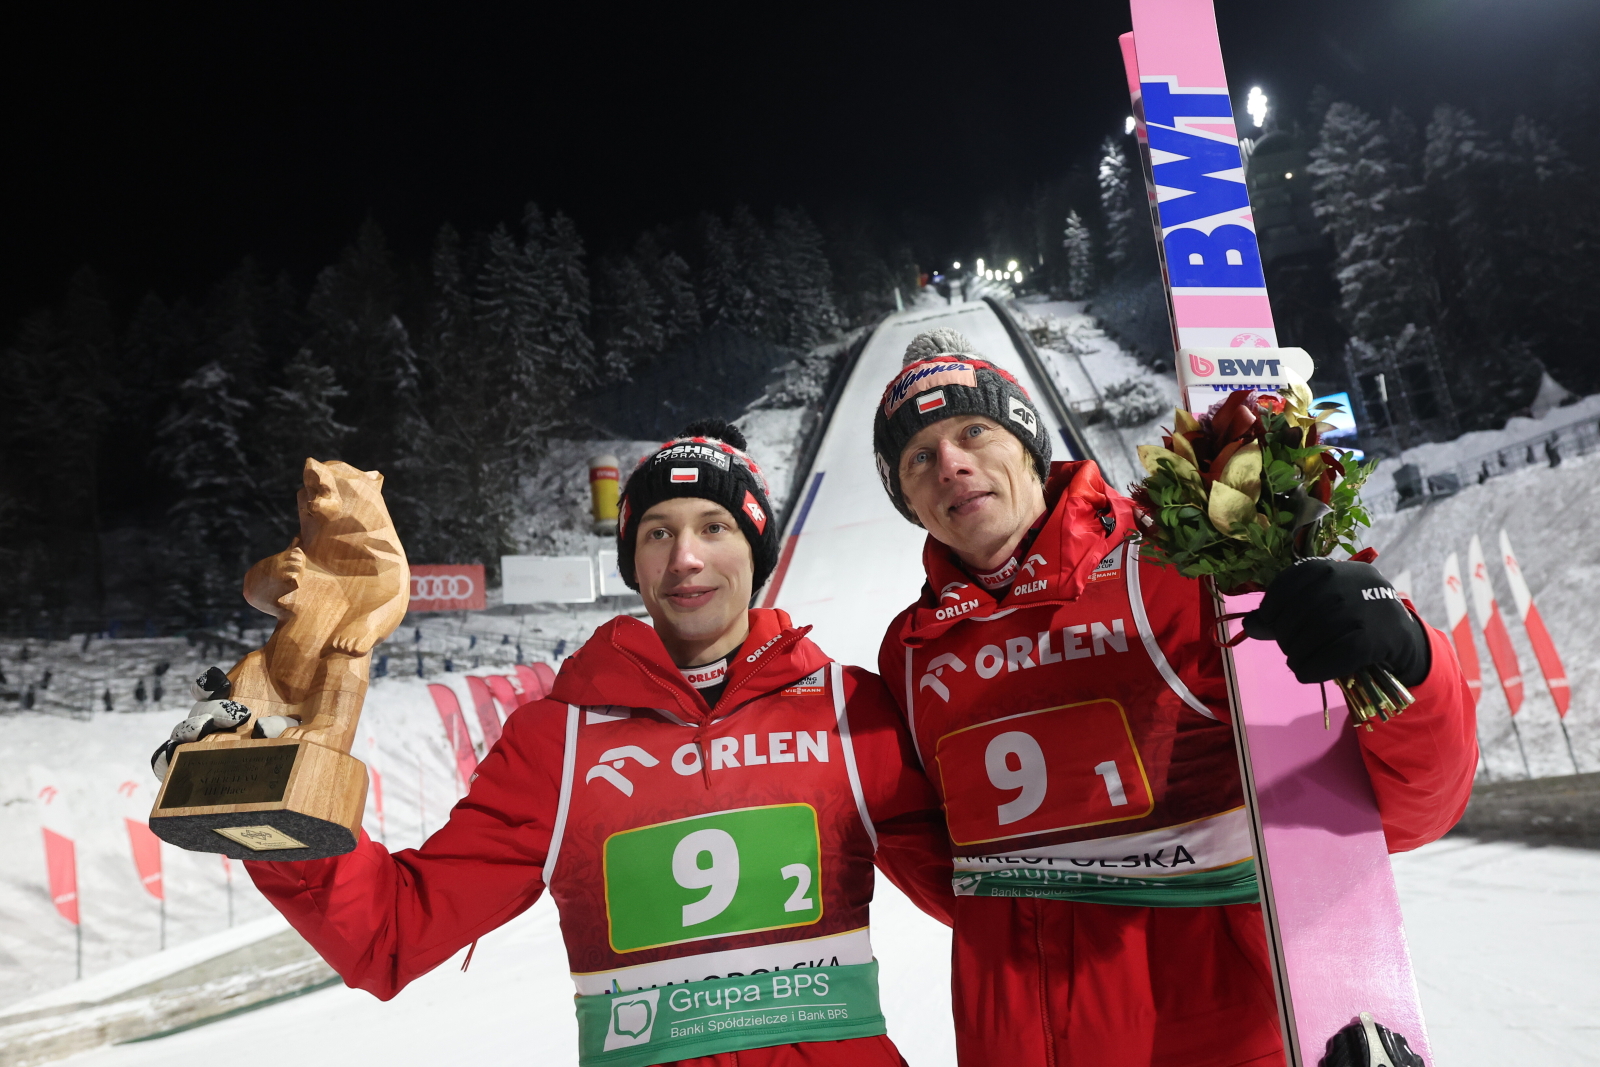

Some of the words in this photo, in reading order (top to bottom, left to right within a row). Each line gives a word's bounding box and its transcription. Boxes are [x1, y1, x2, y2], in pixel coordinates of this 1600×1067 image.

[1140, 81, 1266, 288] BWT
[1218, 359, 1280, 376] BWT
[887, 362, 972, 410] Manner
[1012, 407, 1035, 426] 4F
[654, 453, 726, 468] HYDRATION
[656, 445, 726, 462] OSHEE
[983, 564, 1018, 585] ORLEN
[1014, 580, 1048, 596] ORLEN
[935, 599, 979, 621] ORLEN
[746, 634, 783, 663] ORLEN
[975, 618, 1129, 679] ORLEN
[687, 667, 725, 684] ORLEN
[671, 730, 830, 776] ORLEN
[984, 731, 1048, 826] 9
[1094, 760, 1129, 807] 1
[220, 786, 246, 795] Place
[672, 828, 740, 928] 9
[780, 863, 814, 913] 2
[991, 887, 1021, 897] Banki
[668, 984, 761, 1012] Grupa
[772, 973, 830, 999] BPS
[670, 1023, 704, 1038] Banki
[708, 1013, 788, 1032] Spółdzielcze
[791, 1011, 795, 1022] i
[798, 1010, 826, 1021] Bank
[828, 1008, 849, 1020] BPS
